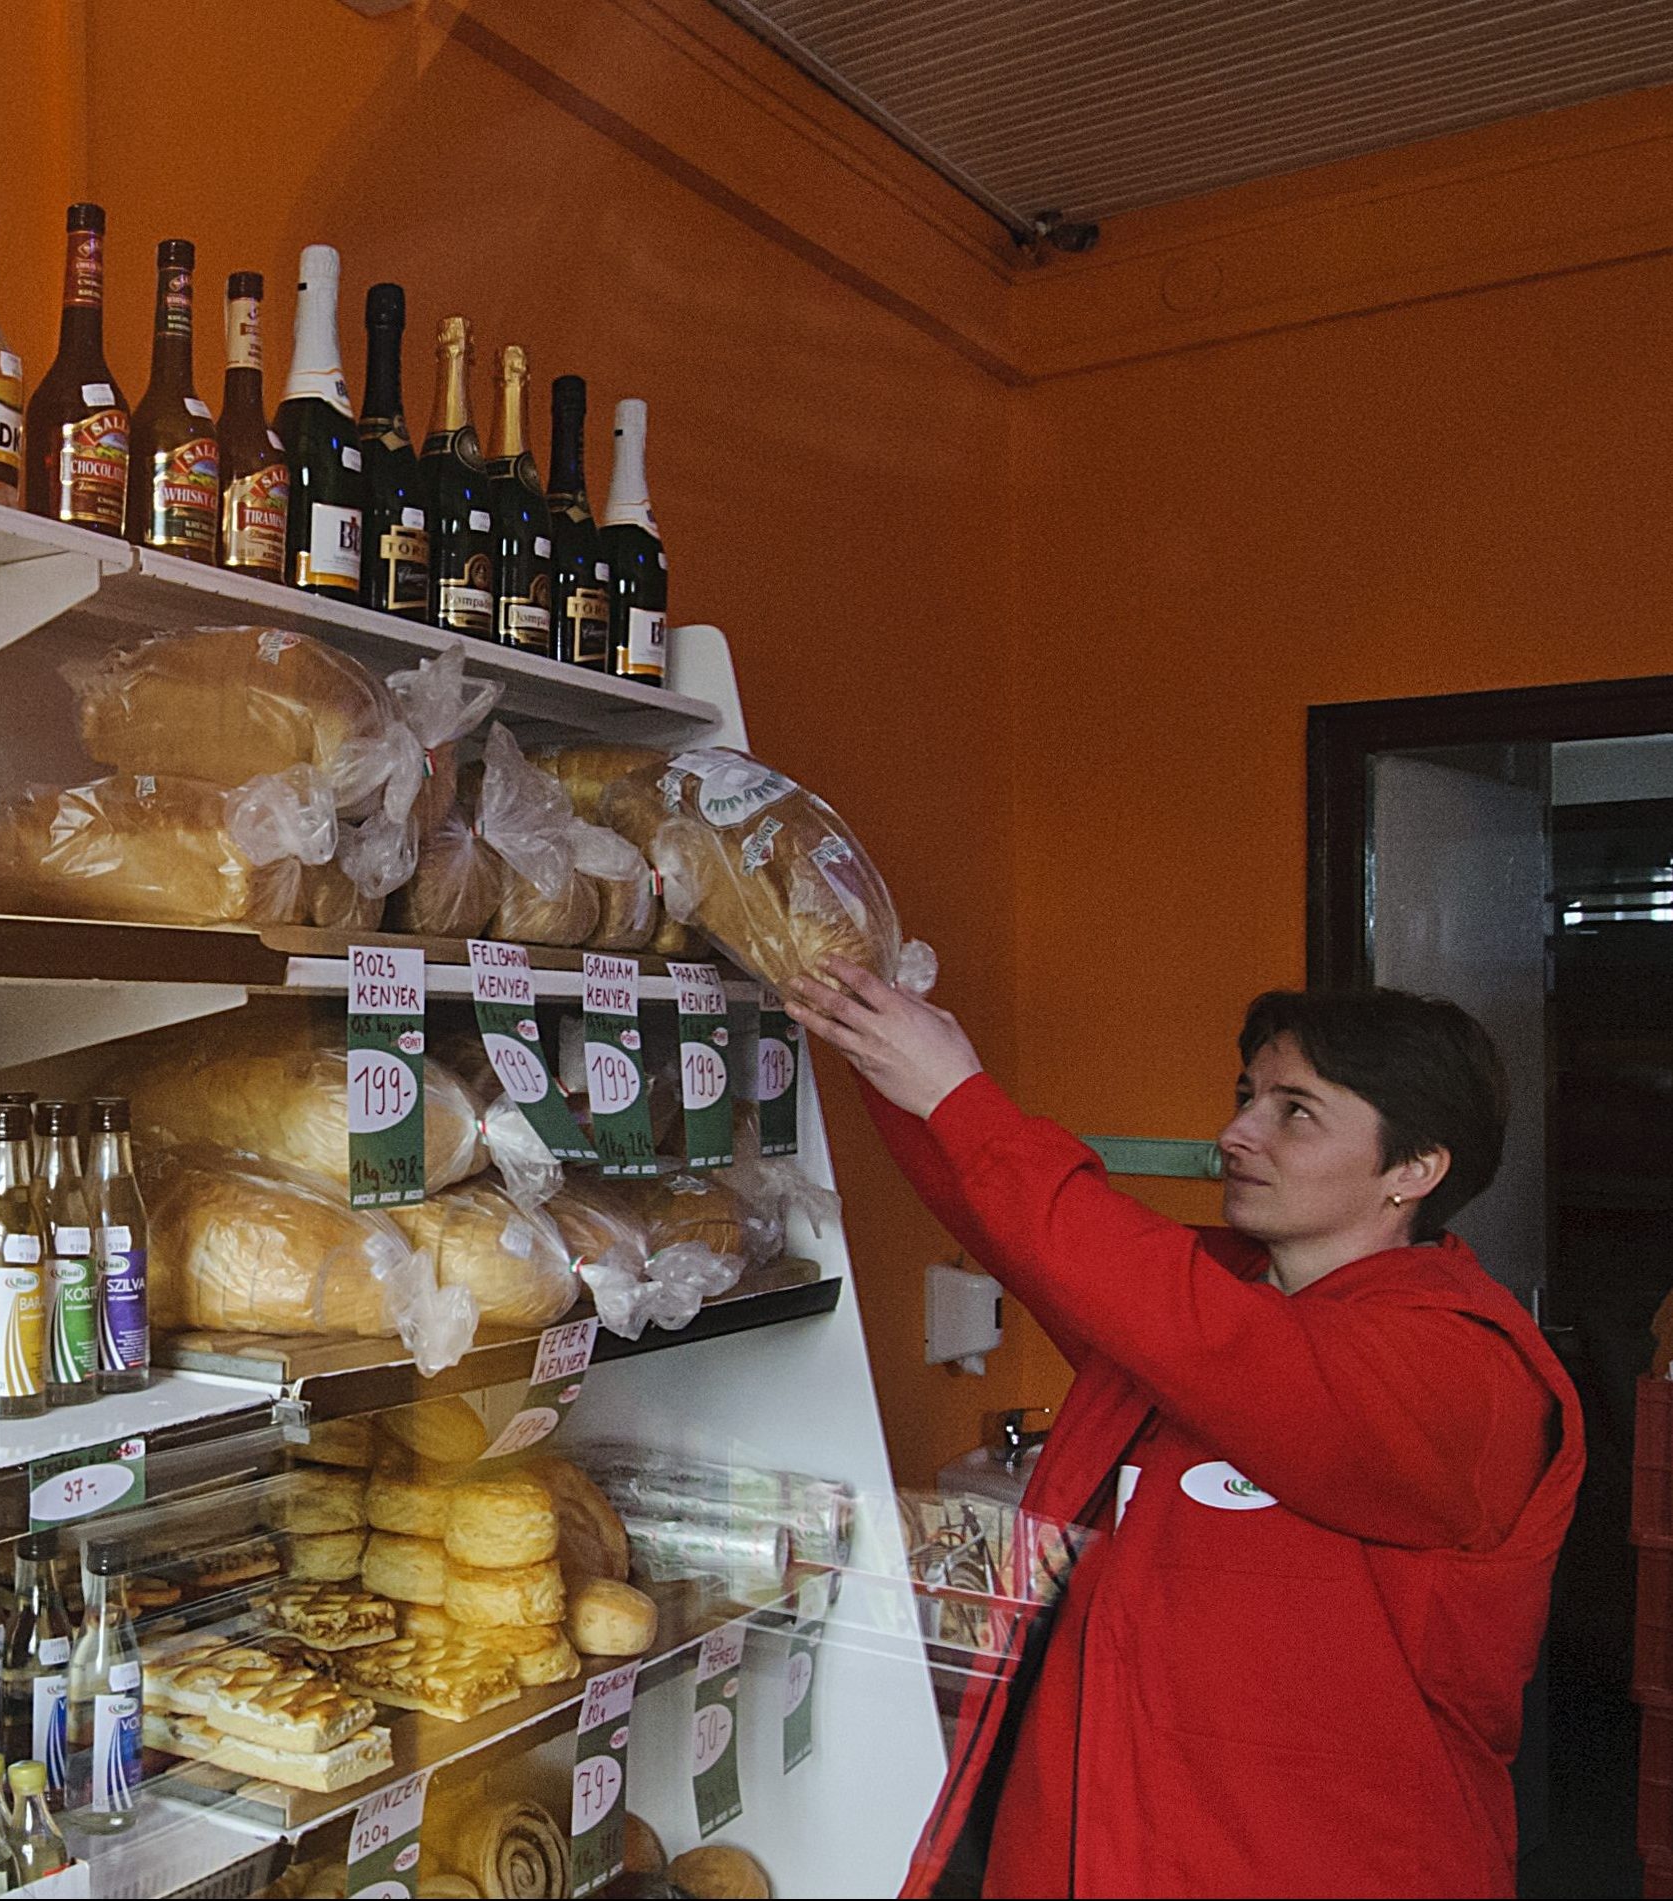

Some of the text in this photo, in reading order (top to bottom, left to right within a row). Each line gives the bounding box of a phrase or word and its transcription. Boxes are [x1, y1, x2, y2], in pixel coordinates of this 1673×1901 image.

[353, 949, 396, 979] ROZS
[585, 956, 633, 982] GRAHAM
[106, 1277, 145, 1293] SZILVA
